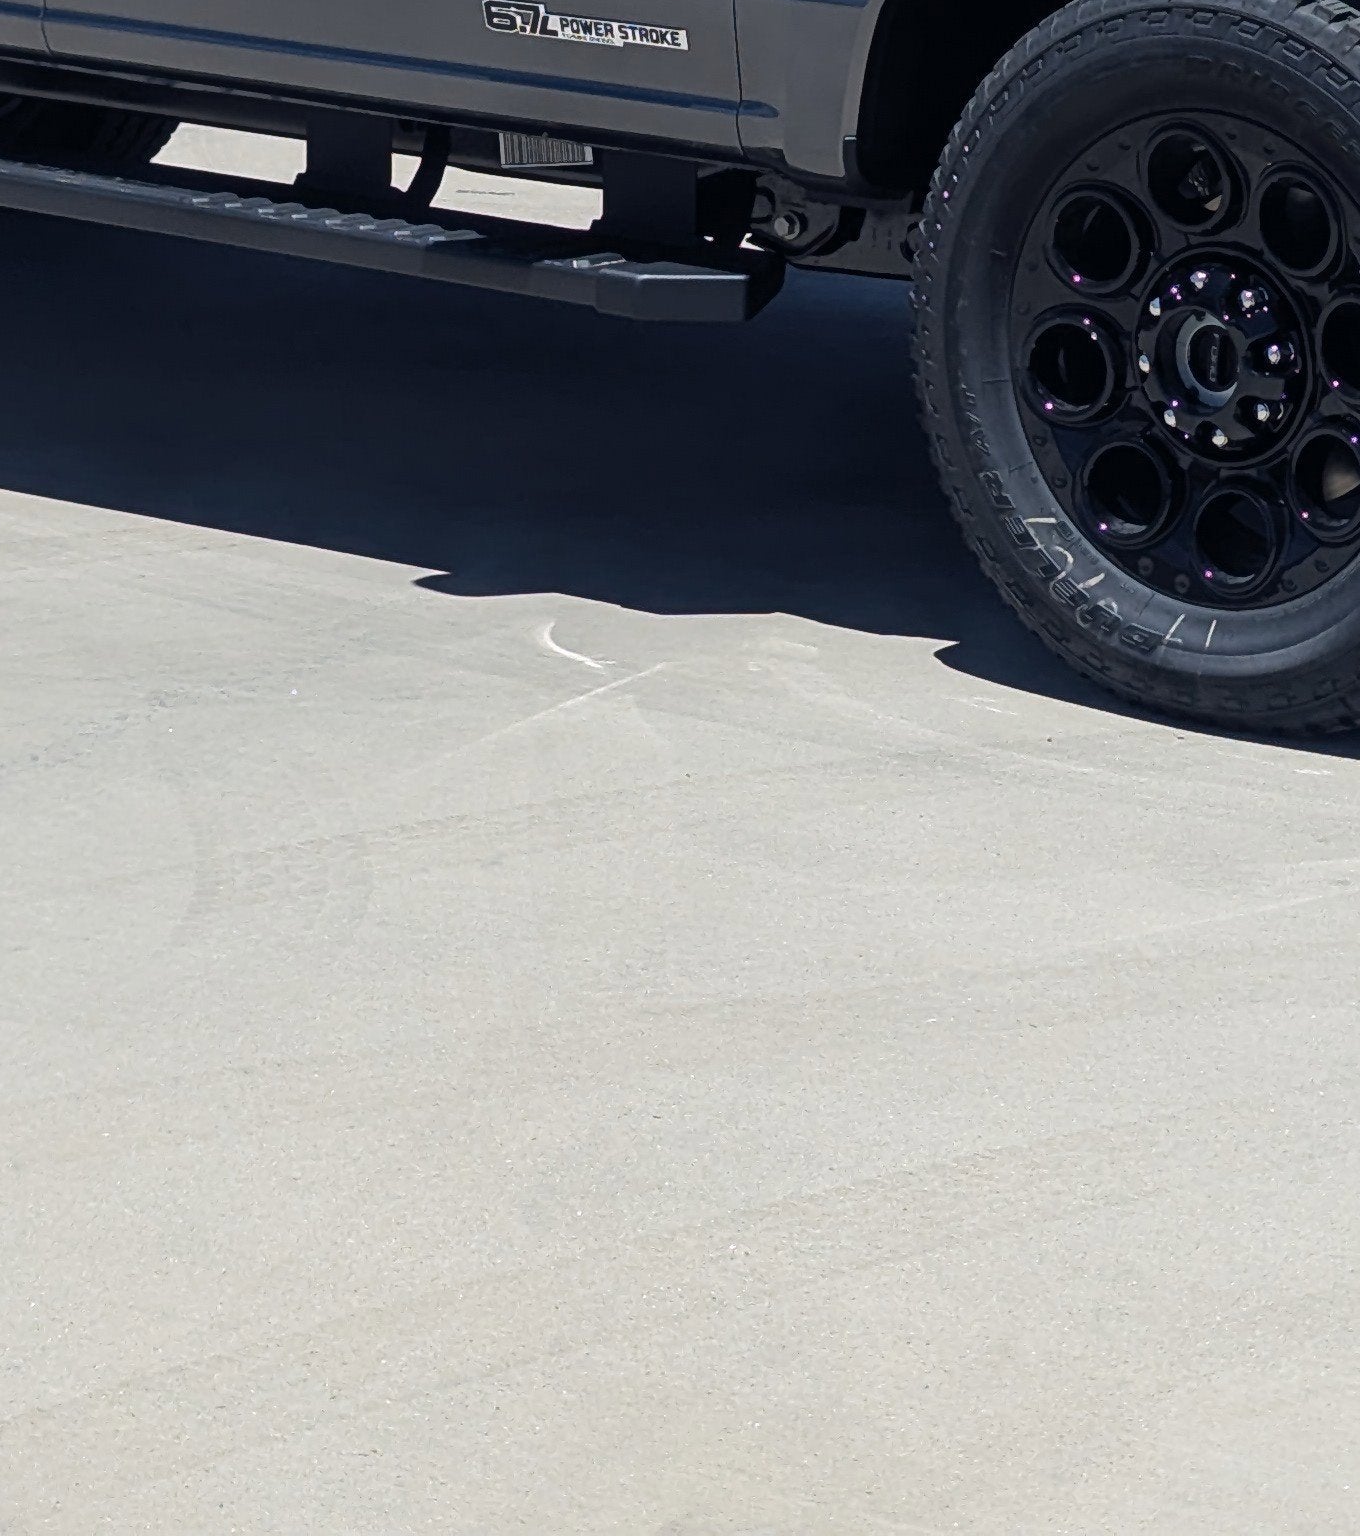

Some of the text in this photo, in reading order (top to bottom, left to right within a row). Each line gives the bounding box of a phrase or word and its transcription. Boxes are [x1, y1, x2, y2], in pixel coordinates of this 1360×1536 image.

[483, 0, 559, 36] 6.7L
[559, 16, 617, 39] POWER
[618, 24, 682, 47] STROKE
